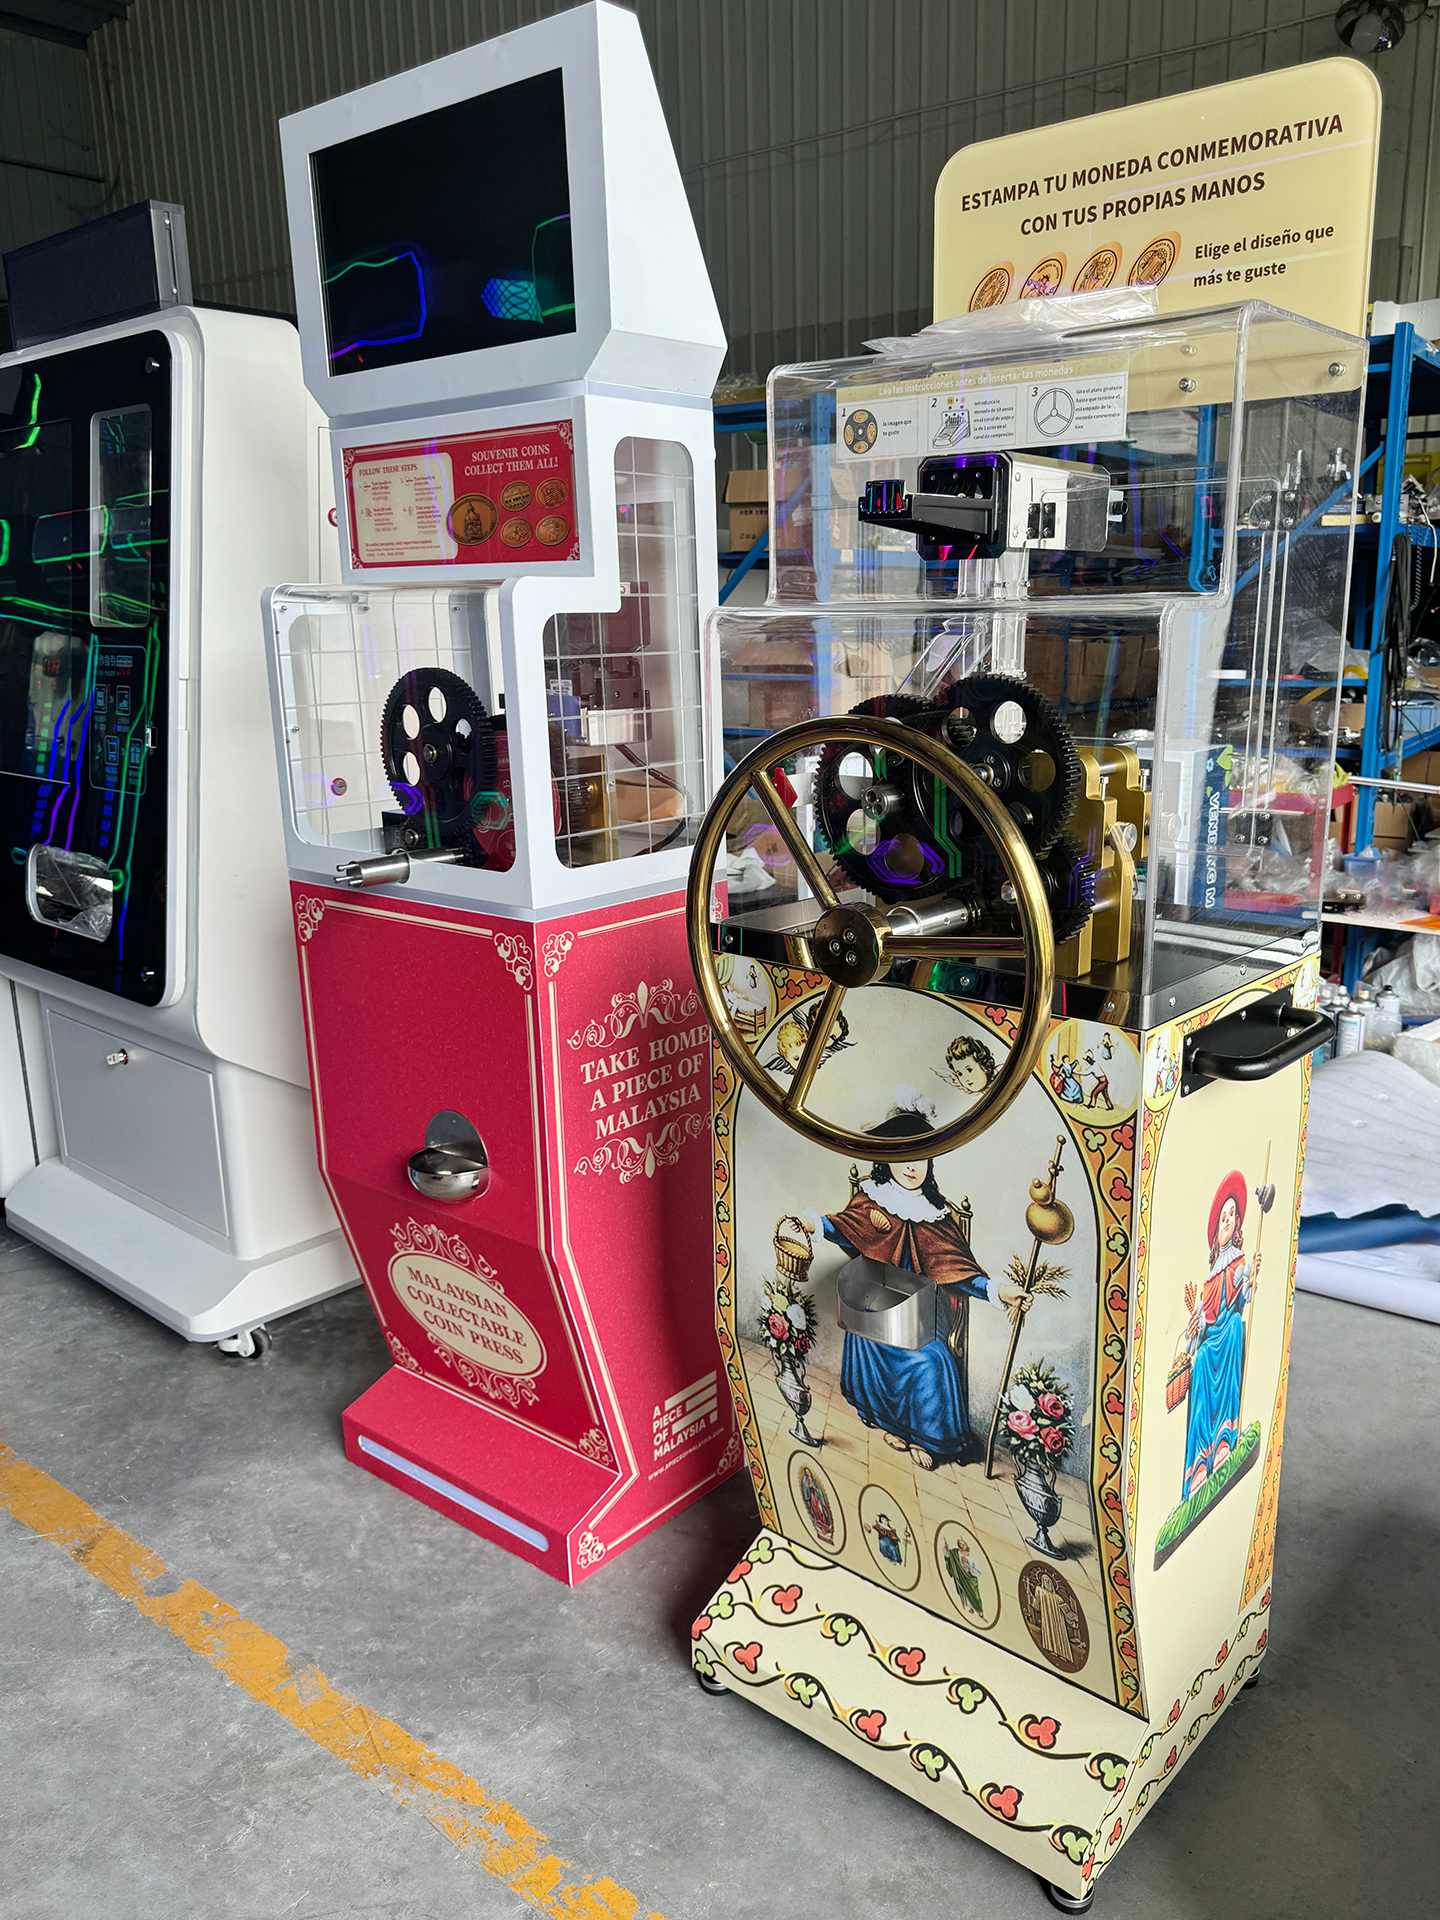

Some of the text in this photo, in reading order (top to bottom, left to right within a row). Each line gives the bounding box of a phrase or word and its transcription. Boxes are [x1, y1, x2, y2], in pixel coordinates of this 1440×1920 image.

[961, 114, 1343, 212] ESTAMPA TU MONEDA CONMEMORATIVA
[1020, 171, 1266, 236] CON TUS PROPIAS MANOS
[1195, 225, 1335, 260] Elige el diseño que
[1193, 261, 1287, 287] más te guste
[879, 366, 1074, 396] Lea las instrucciones antes de insertar las monedas
[1031, 386, 1039, 397] 3
[841, 408, 846, 418] 1
[931, 397, 938, 408] 2
[464, 456, 559, 476] COLLECT THEM ALL!
[471, 443, 550, 462] SOUVENIR COINS
[359, 467, 382, 476] FOLLOW
[382, 465, 400, 474] THESE
[580, 1024, 710, 1085] TAKE HOME
[590, 1053, 704, 1112] A PIECE OF
[595, 1083, 702, 1140] MALAYSIA
[407, 1266, 509, 1320] MALAYSIAN
[407, 1285, 527, 1347] COLLECTABLE
[423, 1310, 524, 1365] COIN PRESS
[653, 1405, 662, 1420] A
[653, 1405, 682, 1434] PIECE
[653, 1429, 669, 1446] OF
[653, 1418, 706, 1461] MALAYSIA
